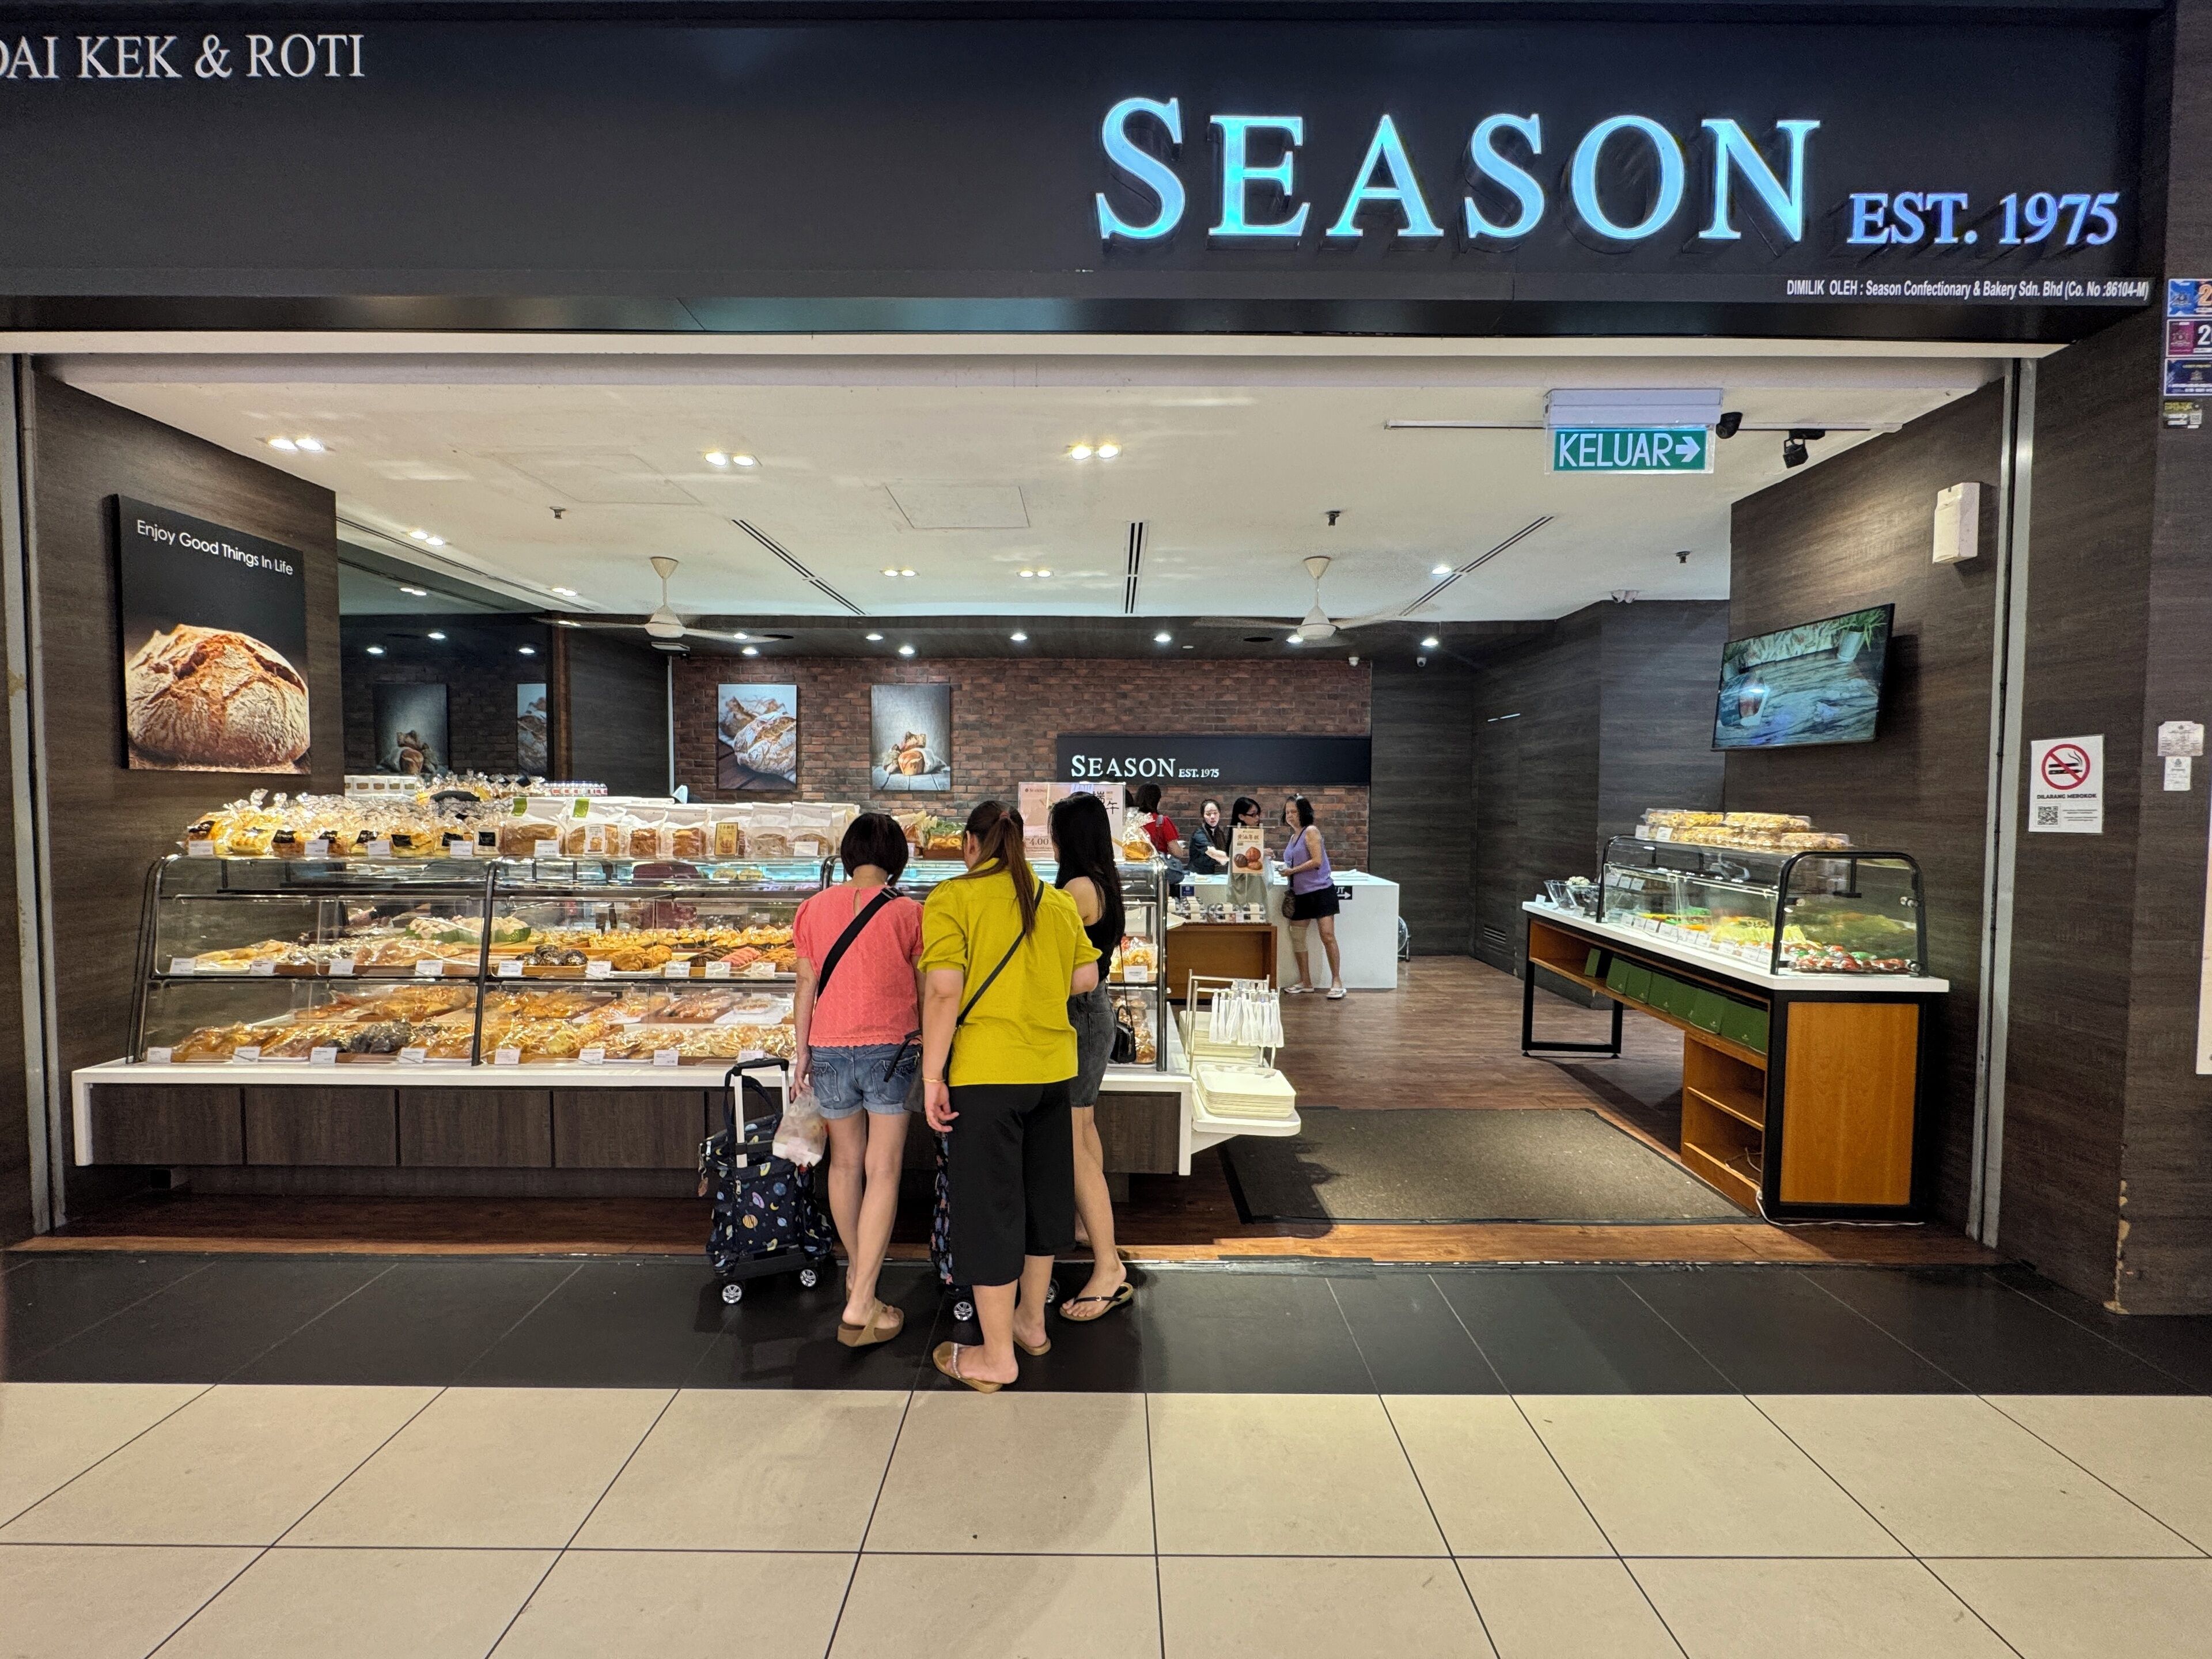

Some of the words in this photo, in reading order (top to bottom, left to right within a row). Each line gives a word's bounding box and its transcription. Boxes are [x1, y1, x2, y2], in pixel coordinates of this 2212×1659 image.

[0, 36, 60, 79] AI
[76, 36, 183, 78] KEK
[195, 34, 233, 78] &
[245, 33, 365, 78] ROTI
[1096, 97, 1820, 241] SEASON
[1847, 191, 1978, 245] EST.
[1998, 191, 2120, 245] 1975
[1787, 279, 1825, 296] DIMILIK
[1829, 279, 1858, 296] OLEH
[1865, 280, 1902, 296] Season
[1903, 280, 1972, 300] Confectionary
[1972, 280, 1981, 296] &
[1982, 281, 2017, 301] Bakery
[2018, 281, 2040, 297] Sdn.
[2042, 281, 2063, 297] Bhd
[2064, 281, 2085, 301] (Co.
[2086, 281, 2101, 297] No
[1559, 433, 1673, 467] KELUAR
[137, 520, 176, 546] Enjoy
[179, 532, 219, 555] Good
[222, 543, 259, 567] Things
[262, 555, 272, 570] In
[275, 558, 294, 575] Life
[1071, 755, 1176, 778] SEASON
[1178, 768, 1199, 778] EST.
[1200, 768, 1219, 778] 1975
